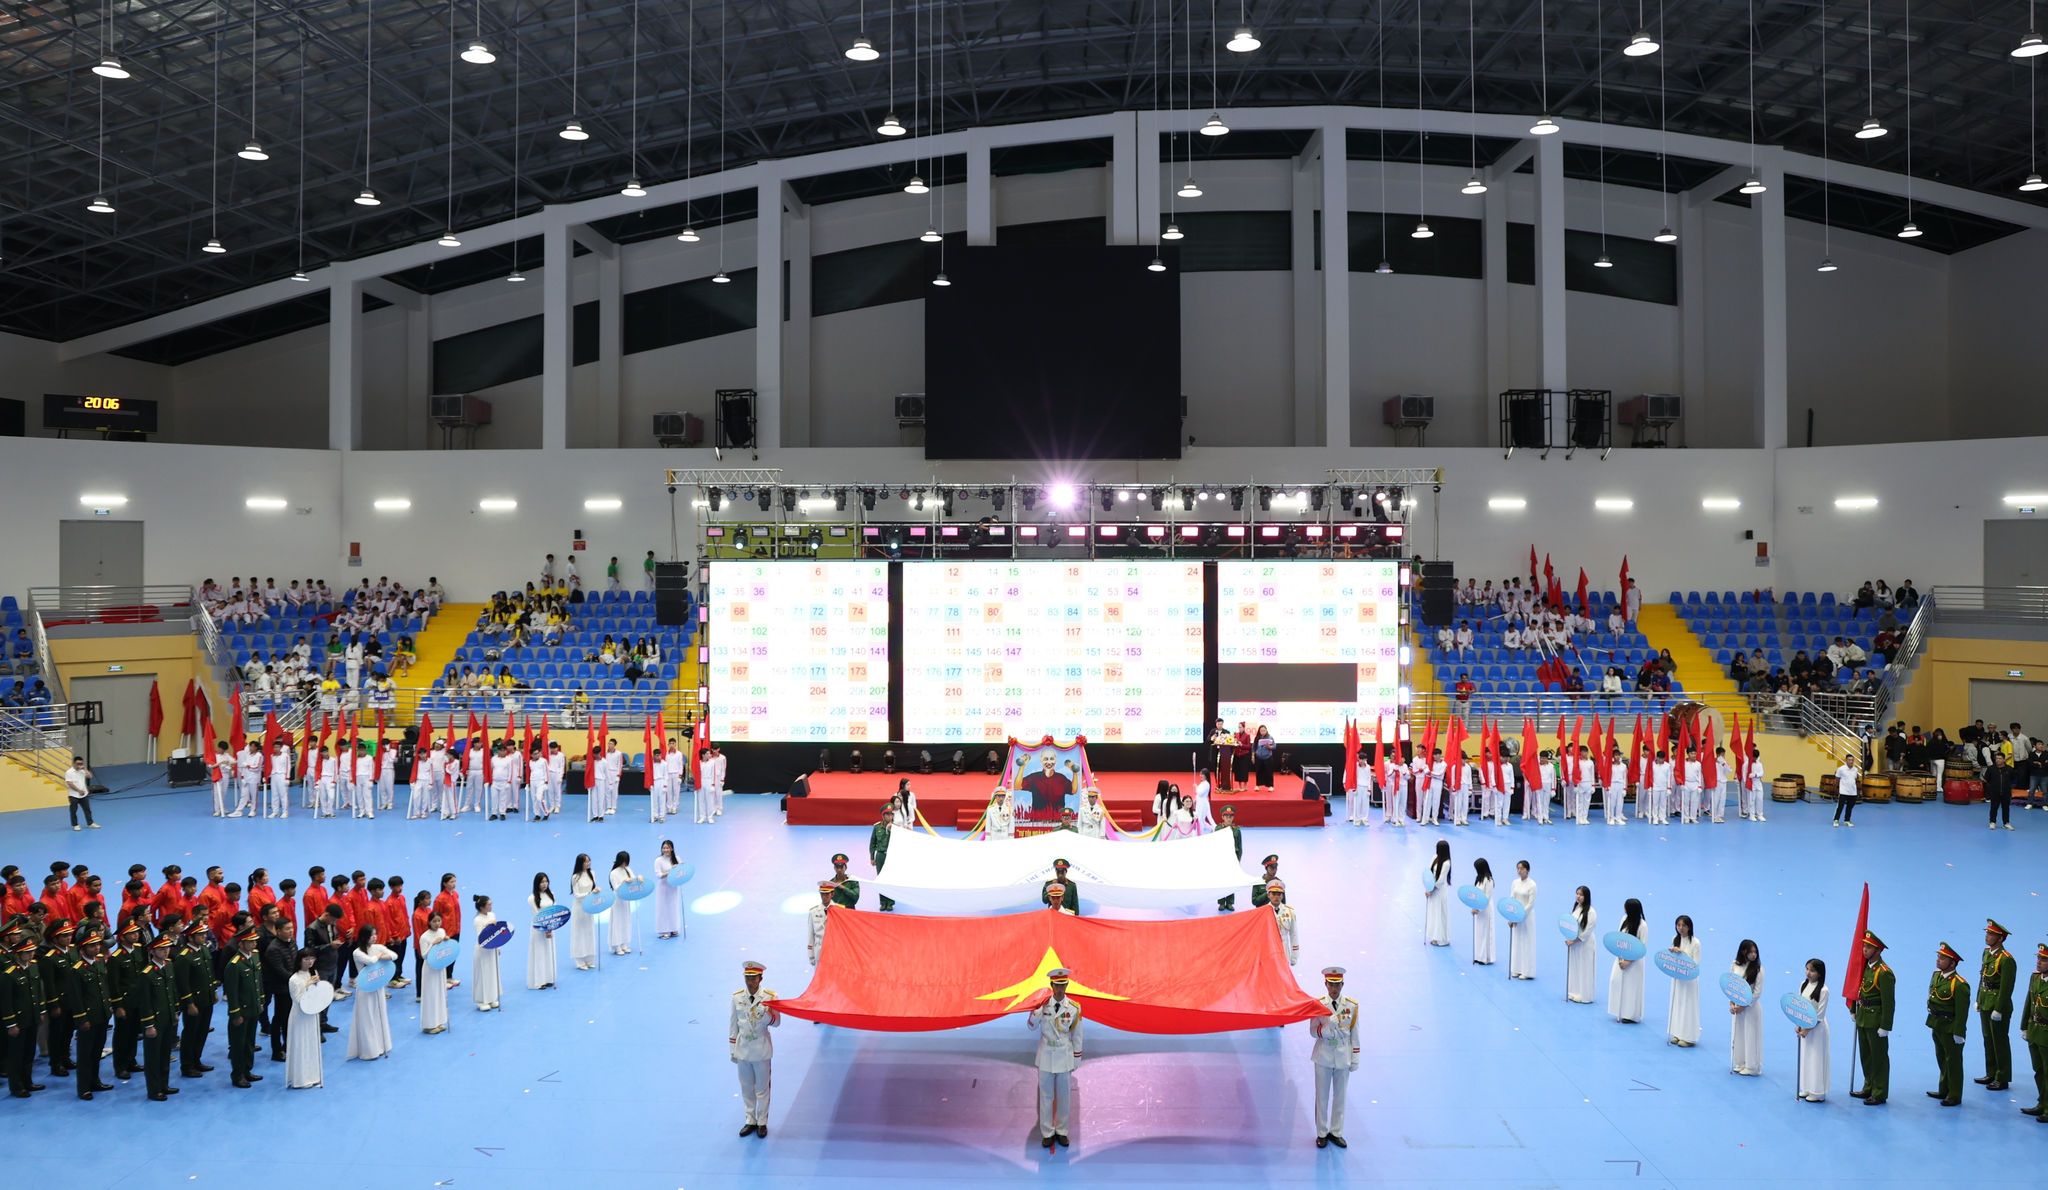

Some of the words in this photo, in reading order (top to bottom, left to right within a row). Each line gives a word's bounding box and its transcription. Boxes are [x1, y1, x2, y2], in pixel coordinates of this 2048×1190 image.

[756, 568, 762, 576] 3
[816, 568, 821, 576] 6
[875, 568, 880, 576] 9
[949, 568, 959, 576] 12
[1009, 568, 1019, 576] 15
[1068, 568, 1079, 576] 18
[1128, 568, 1137, 576] 21
[1188, 568, 1198, 576] 24
[1263, 568, 1274, 576] 27
[1323, 568, 1334, 576] 30
[1382, 568, 1393, 576] 33
[715, 588, 725, 596] 34
[754, 588, 765, 596] 36
[833, 588, 843, 596] 40
[852, 588, 863, 596] 41
[872, 588, 883, 596] 42
[968, 588, 979, 596] 46
[988, 588, 998, 596] 47
[1008, 588, 1018, 596] 48
[1088, 588, 1098, 596] 52
[1128, 588, 1138, 596] 54
[1224, 588, 1234, 596] 58
[1263, 588, 1274, 596] 60
[1342, 588, 1353, 596] 64
[1382, 588, 1393, 596] 66
[734, 607, 745, 616] 68
[813, 607, 823, 616] 72
[852, 607, 863, 616] 74
[948, 608, 959, 616] 78
[988, 608, 1000, 616] 80
[1067, 608, 1078, 616] 84
[1243, 608, 1254, 616] 92
[1323, 608, 1334, 616] 96
[1362, 608, 1373, 616] 98
[752, 627, 767, 636] 102
[811, 627, 826, 636] 105
[871, 627, 886, 636] 108
[946, 628, 962, 636] 111
[1007, 628, 1020, 636] 114
[1066, 628, 1080, 636] 117
[1126, 628, 1142, 636] 120
[1186, 628, 1201, 636] 123
[1262, 628, 1277, 636] 126
[1321, 628, 1336, 636] 129
[1381, 628, 1395, 636] 132
[752, 647, 767, 655] 135
[832, 647, 846, 655] 139
[851, 647, 866, 655] 140
[871, 647, 885, 655] 141
[947, 648, 961, 656] 144
[966, 648, 981, 656] 145
[987, 648, 1001, 656] 146
[1006, 648, 1021, 656] 147
[1086, 648, 1100, 656] 151
[1126, 648, 1142, 656] 153
[1222, 648, 1237, 656] 157
[1261, 648, 1277, 656] 159
[1341, 648, 1356, 656] 163
[1361, 648, 1375, 656] 164
[1380, 648, 1396, 656] 165
[733, 667, 749, 675] 167
[811, 667, 825, 675] 171
[851, 667, 866, 675] 173
[946, 668, 961, 676] 177
[1066, 668, 1081, 676] 183
[1186, 668, 1201, 676] 189
[1361, 668, 1376, 676] 197
[752, 687, 766, 695] 201
[810, 687, 826, 695] 204
[870, 687, 886, 695] 207
[946, 688, 962, 696] 210
[1005, 688, 1022, 696] 213
[1065, 688, 1082, 696] 216
[1125, 688, 1142, 696] 219
[1185, 688, 1201, 696] 222
[1379, 688, 1394, 696] 231
[752, 707, 767, 715] 234
[870, 707, 886, 715] 240
[966, 708, 981, 716] 244
[985, 708, 1002, 716] 245
[1005, 708, 1021, 716] 246
[1105, 708, 1122, 716] 251
[1125, 708, 1141, 716] 252
[1221, 708, 1237, 716] 256
[1260, 708, 1276, 716] 258
[810, 726, 826, 735] 270
[850, 726, 866, 735] 272
[945, 727, 962, 736] 276
[986, 727, 1002, 736] 278
[1066, 727, 1081, 736] 282
[1105, 727, 1121, 736] 284
[1185, 727, 1201, 736] 288
[1320, 728, 1335, 736] 294
